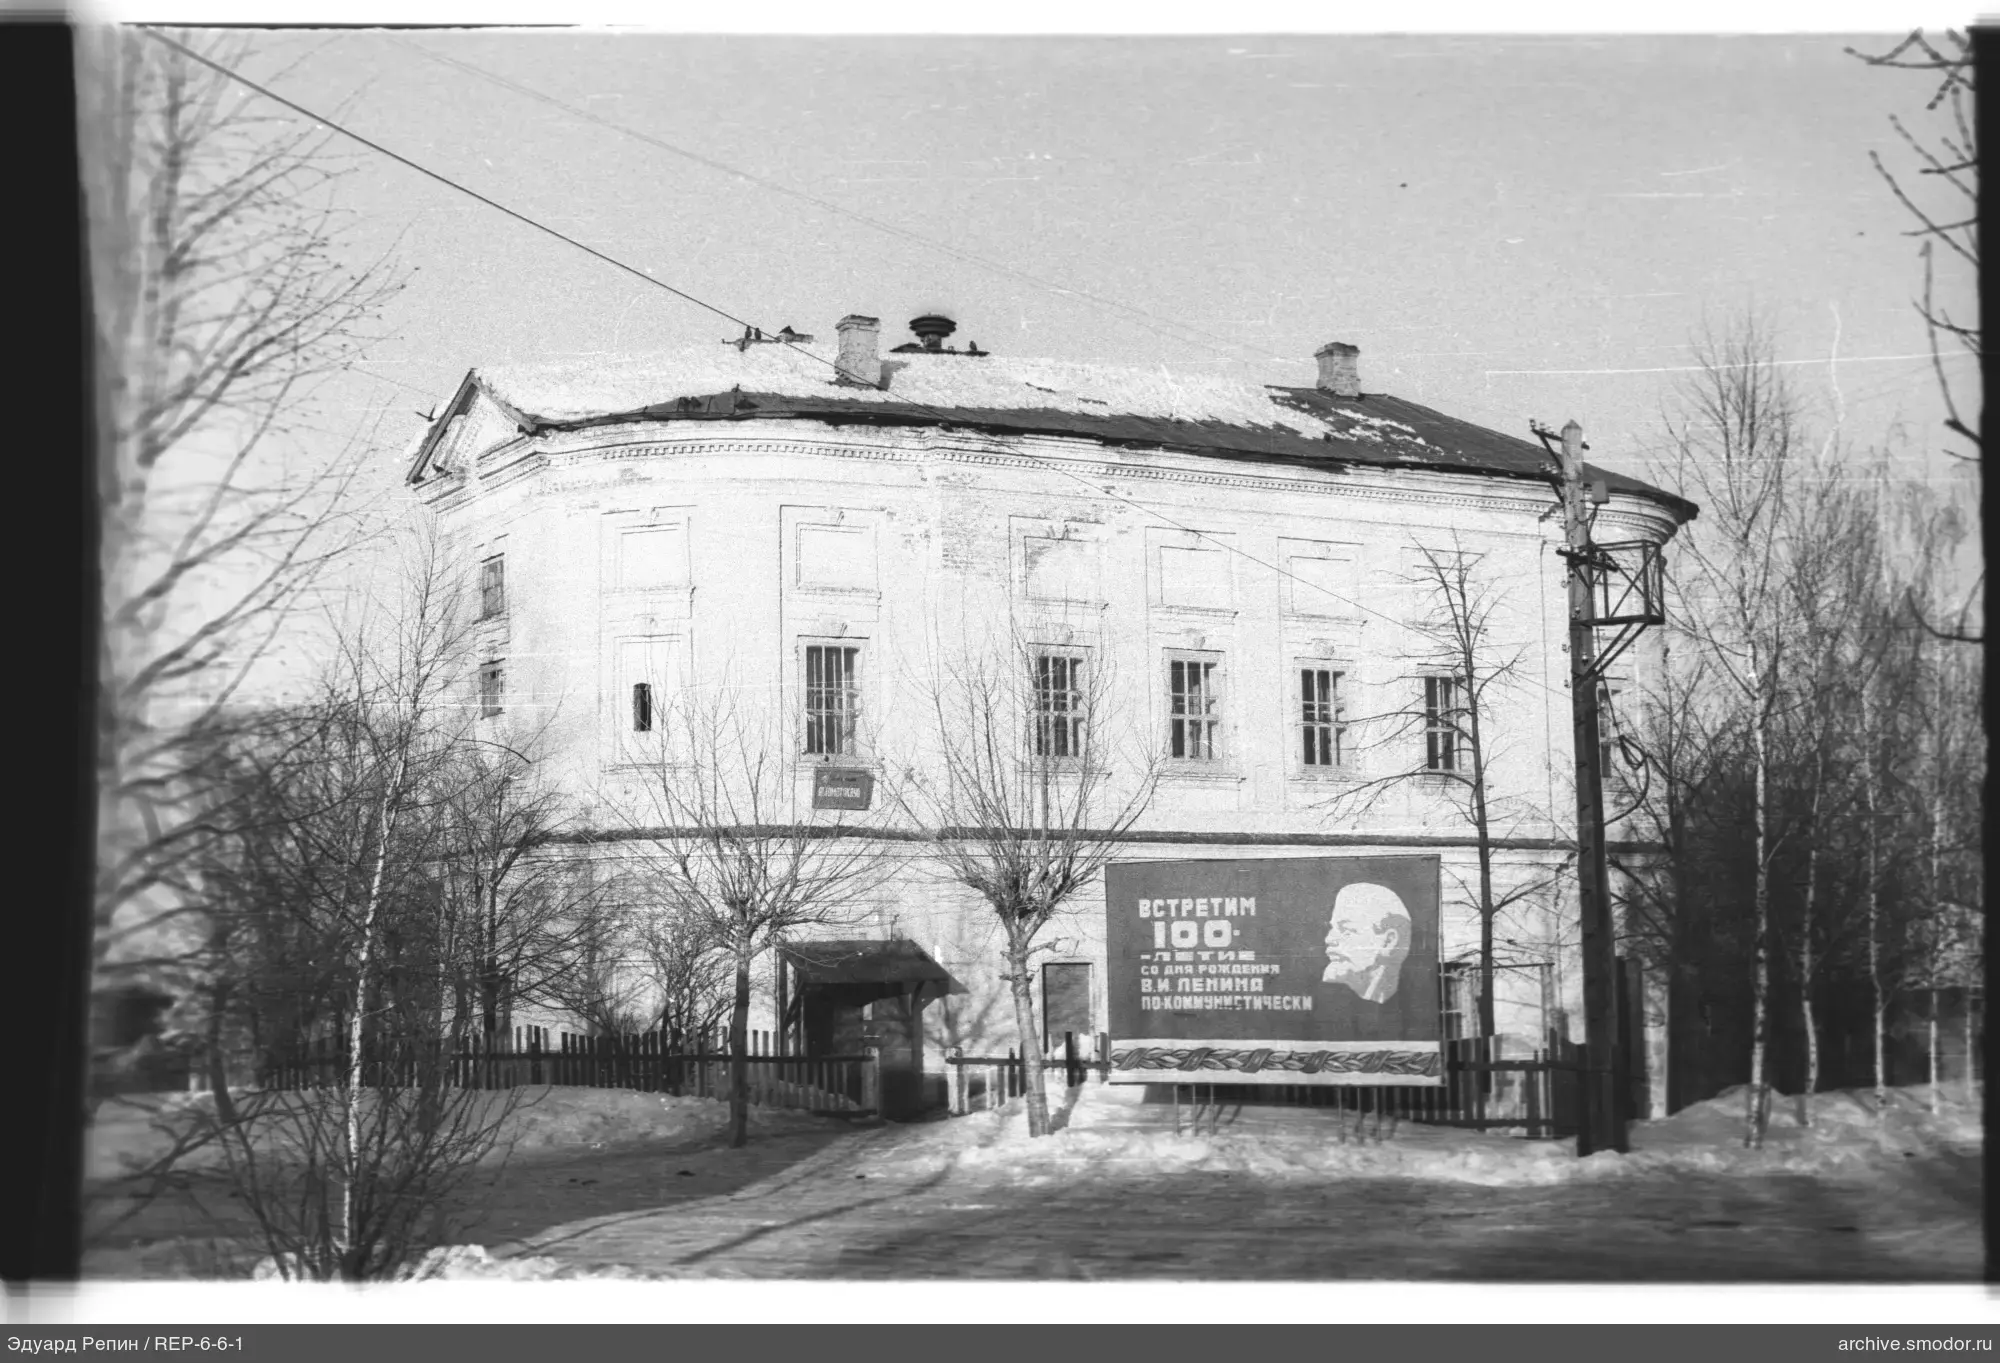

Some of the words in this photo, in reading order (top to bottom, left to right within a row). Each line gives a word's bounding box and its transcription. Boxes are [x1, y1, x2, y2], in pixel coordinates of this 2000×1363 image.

[1139, 897, 1256, 918] ВСТРЕТИМ
[1140, 965, 1160, 976] СО
[1163, 964, 1194, 976] ДНЯ
[1198, 964, 1281, 975] РОЖДЕНИЯ
[1177, 977, 1264, 992] ЛЕНИНА
